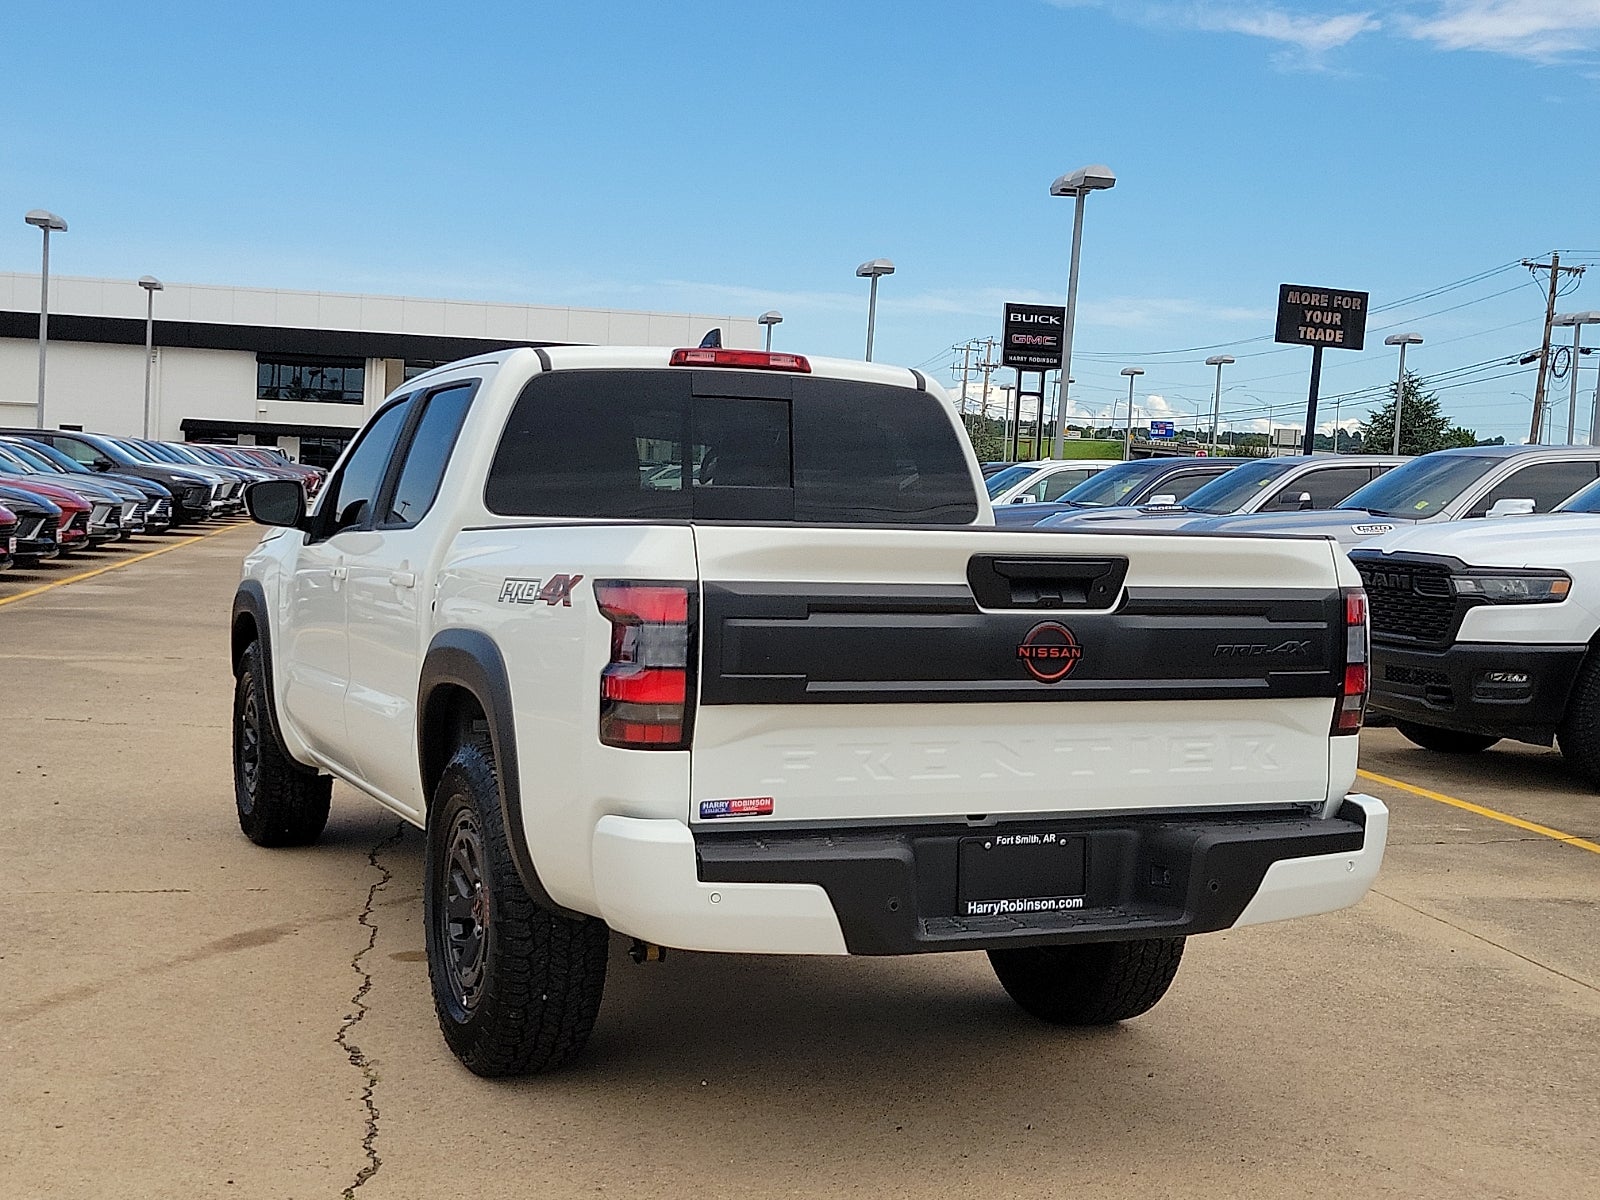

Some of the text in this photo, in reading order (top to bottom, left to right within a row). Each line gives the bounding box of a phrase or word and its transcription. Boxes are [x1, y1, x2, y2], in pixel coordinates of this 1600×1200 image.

[1287, 291, 1362, 310] MORE FOR
[1009, 313, 1061, 325] BUICK
[1304, 309, 1342, 325] YOUR
[1011, 333, 1057, 346] GMC
[1298, 326, 1344, 343] TRADE
[1028, 356, 1058, 364] ROBINSON
[498, 574, 584, 607] PRO-4X
[1018, 646, 1081, 659] NISSAN
[760, 733, 1279, 783] FRONTIER
[702, 798, 771, 810] HARRY ROBINSON
[996, 833, 1056, 845] Fort Smith, AR
[967, 898, 1084, 915] HarryRobinson.com
